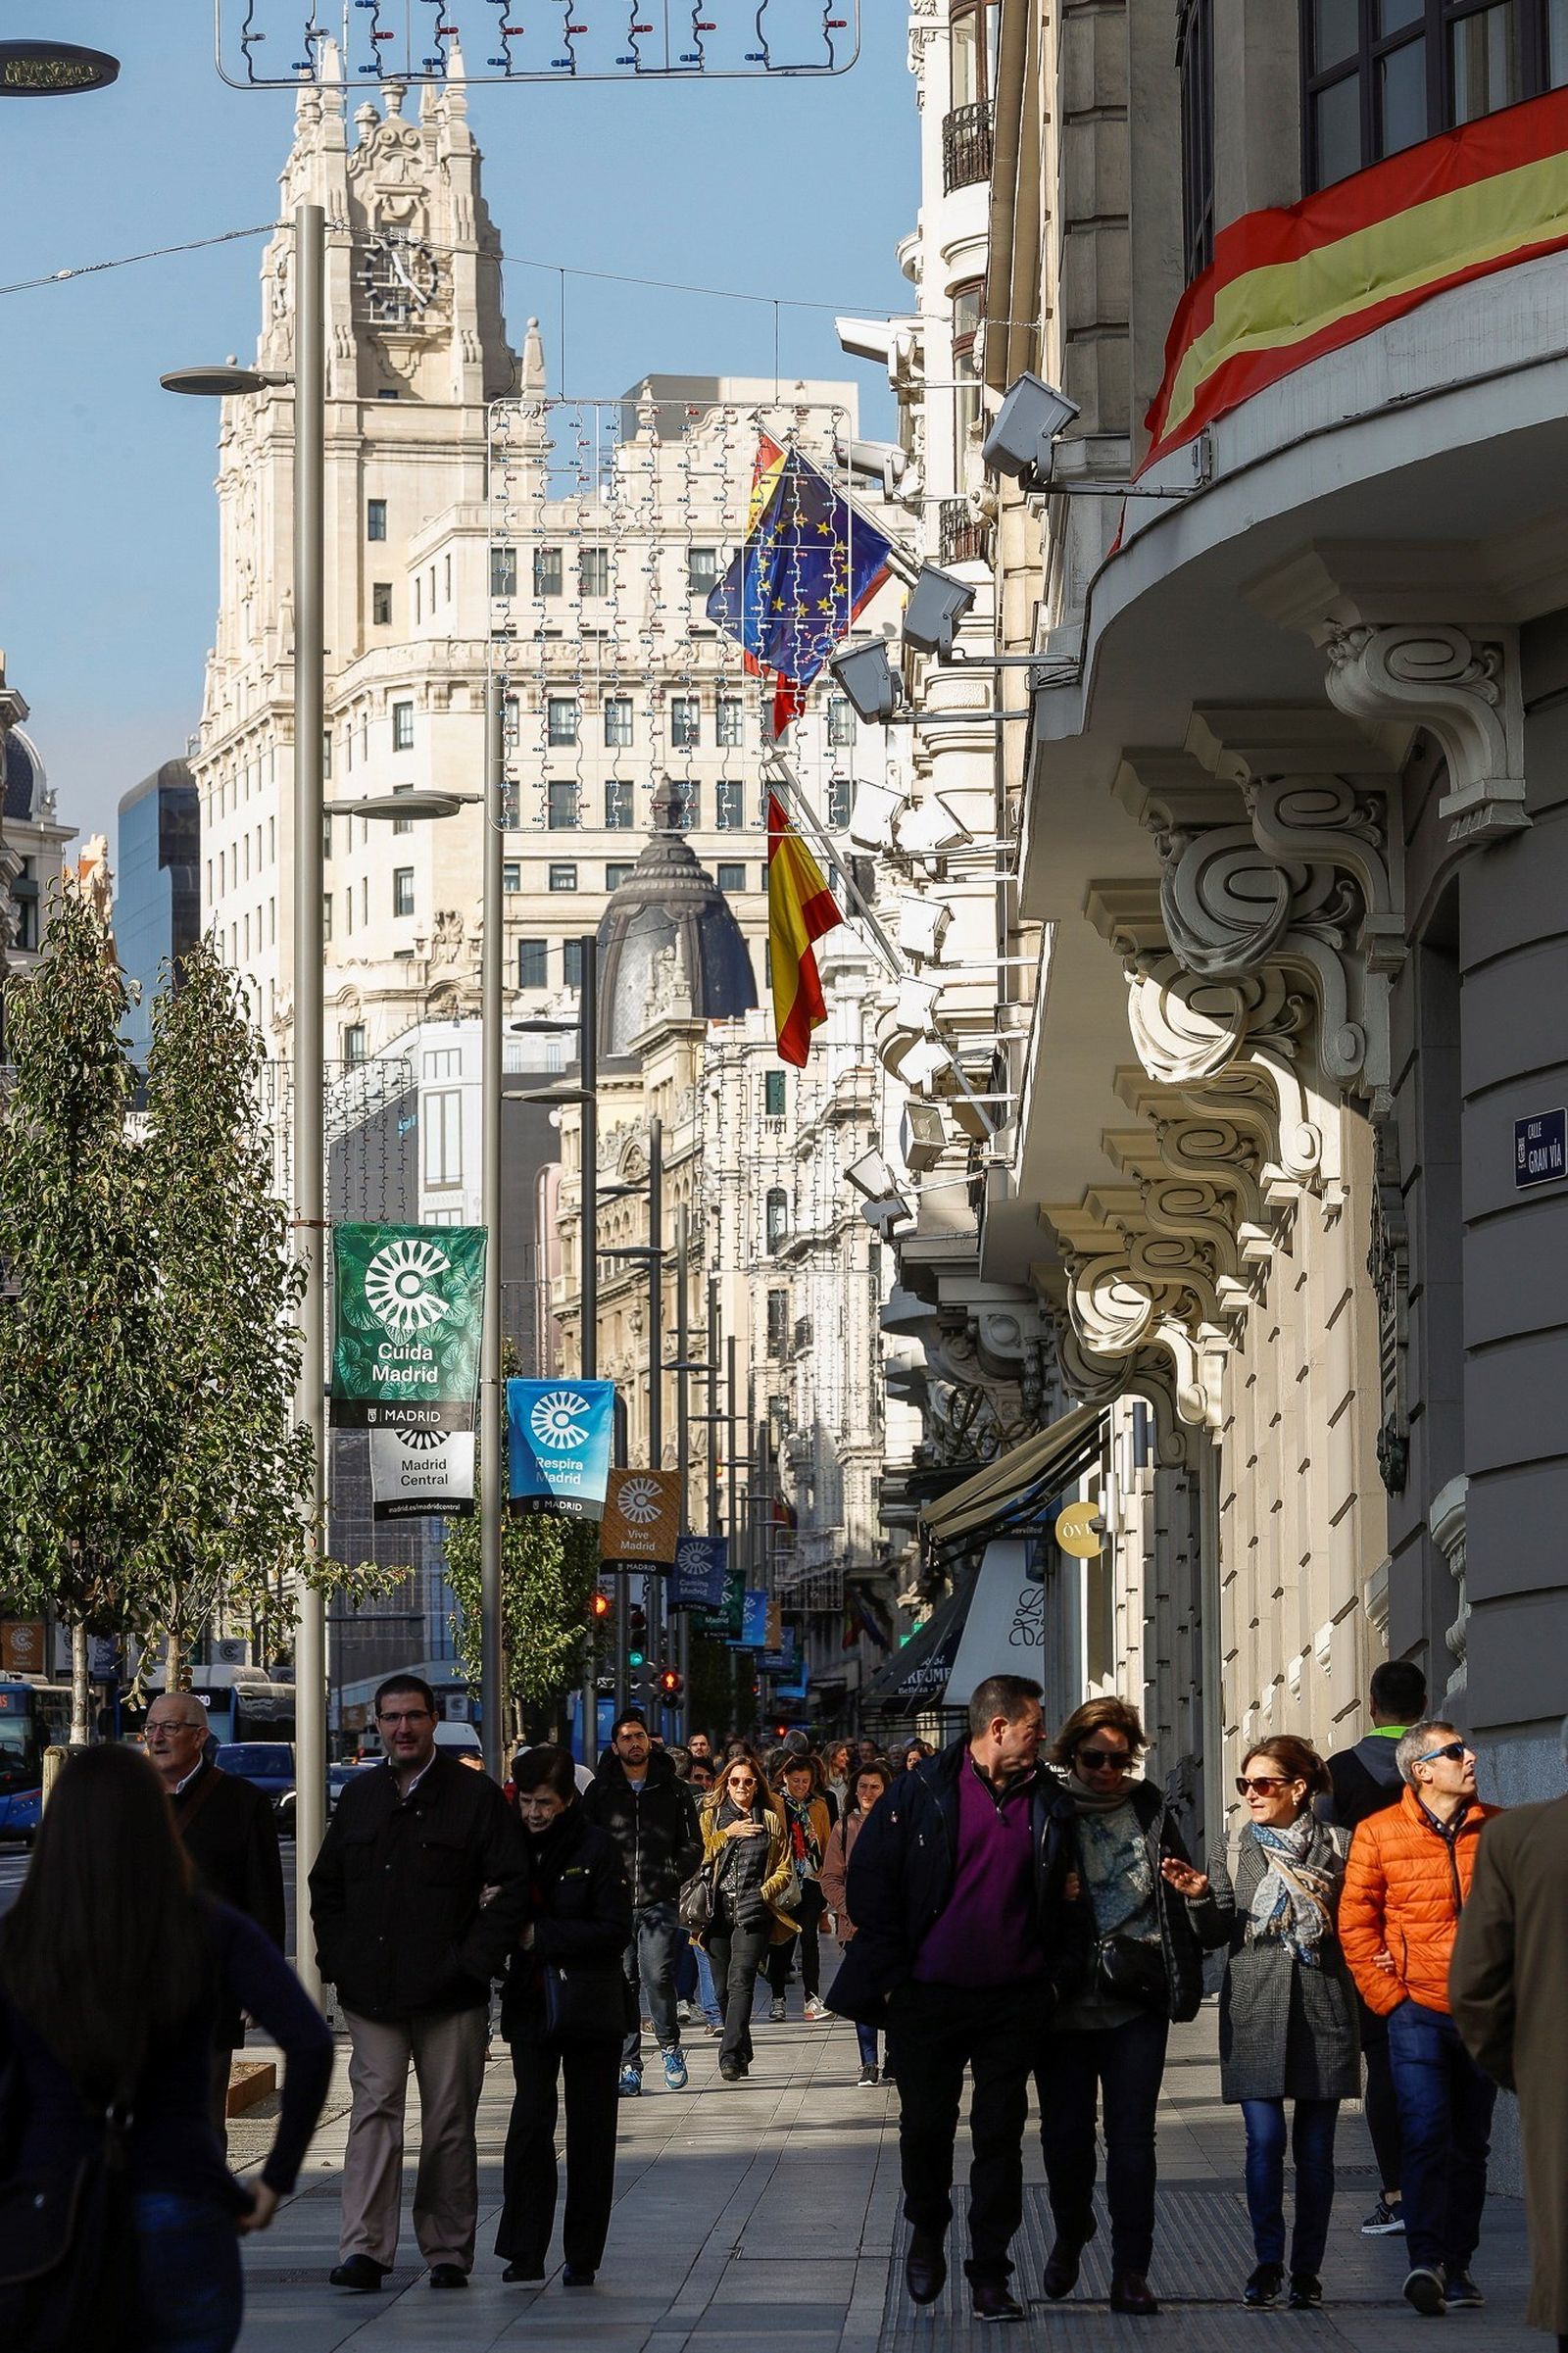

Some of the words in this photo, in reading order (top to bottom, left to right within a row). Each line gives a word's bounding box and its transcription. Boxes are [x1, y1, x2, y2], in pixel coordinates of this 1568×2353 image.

[1528, 1121, 1542, 1139] CALLE
[1529, 1147, 1547, 1173] GRAN
[1549, 1138, 1562, 1168] VÍA
[378, 1343, 433, 1360] Cuida
[372, 1365, 438, 1383] Madrid
[385, 1409, 441, 1422] MADRID
[401, 1458, 447, 1471] Madrid
[536, 1457, 583, 1471] Respira
[400, 1474, 448, 1487] Central
[536, 1471, 581, 1485] Madrid
[544, 1500, 583, 1512] MADRID
[627, 1530, 649, 1540] Vive
[620, 1542, 656, 1552] Madrid
[626, 1563, 657, 1572] MADRID
